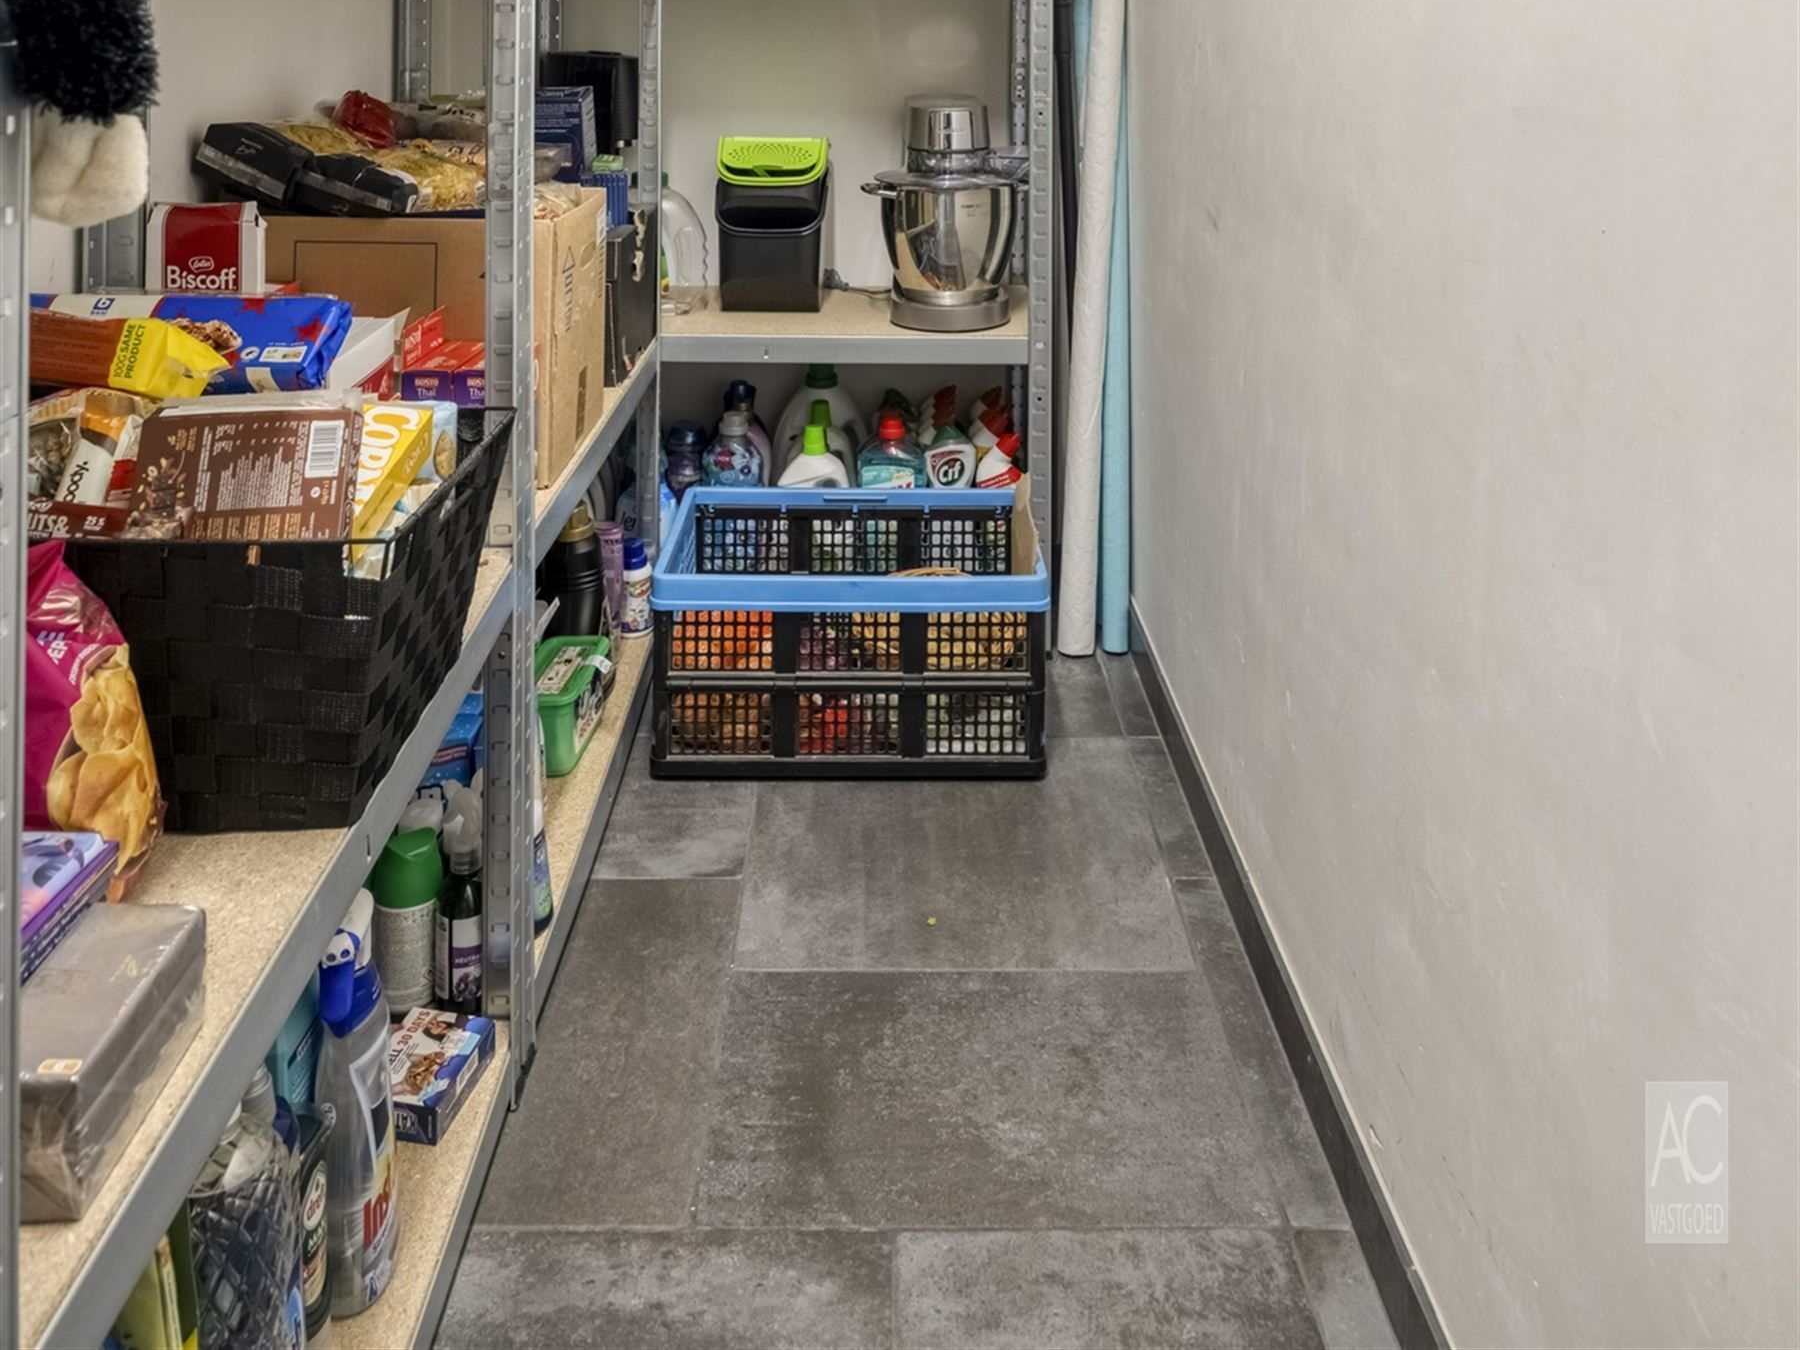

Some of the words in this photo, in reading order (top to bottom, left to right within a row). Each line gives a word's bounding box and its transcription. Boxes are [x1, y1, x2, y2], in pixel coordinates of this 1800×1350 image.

[166, 265, 237, 290] Biscoff
[112, 350, 128, 378] 100G
[120, 323, 137, 352] SAME
[123, 324, 147, 379] PRODUCT
[417, 388, 436, 396] Thai
[938, 464, 962, 483] Cif
[28, 512, 72, 538] UTS&
[408, 1010, 431, 1034] DAYS
